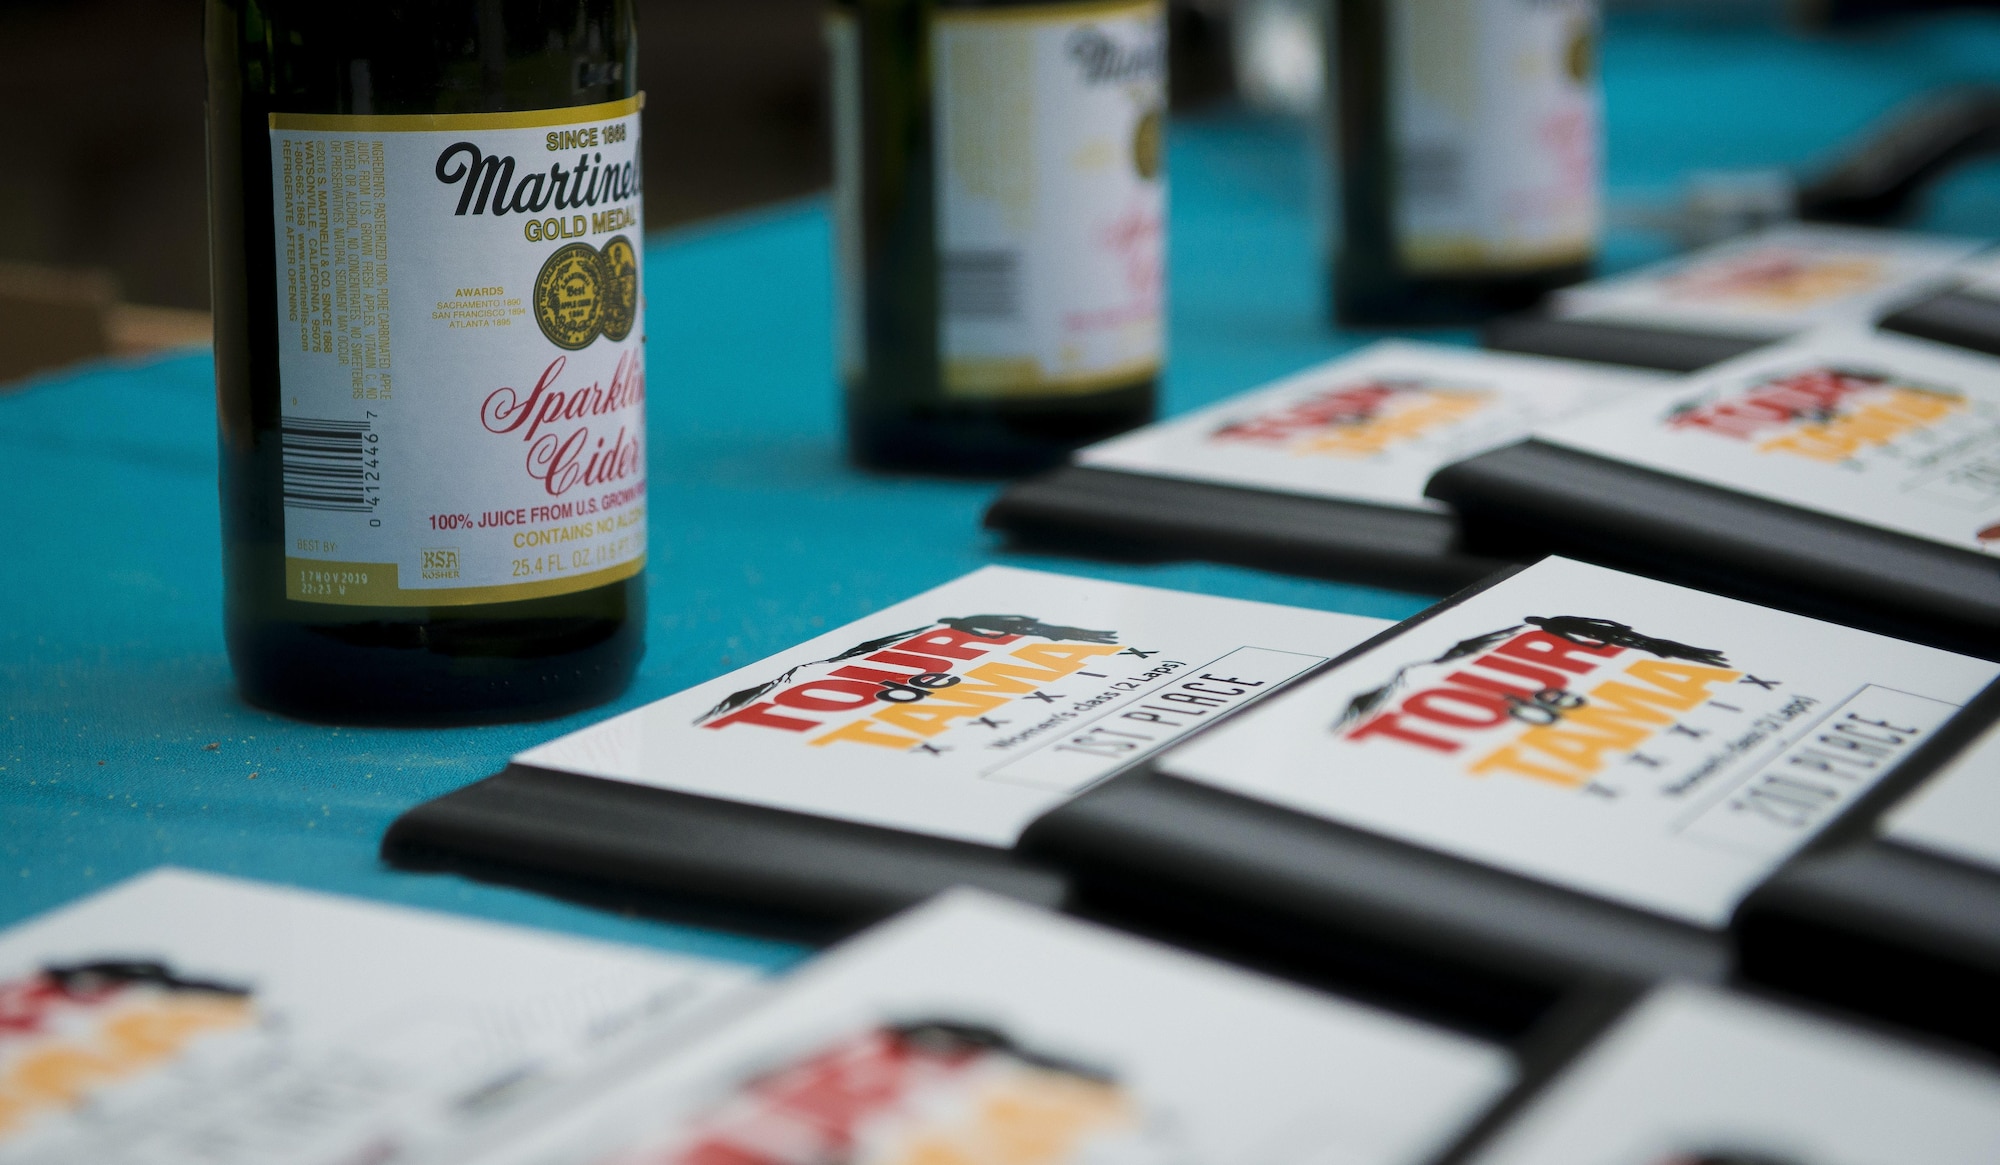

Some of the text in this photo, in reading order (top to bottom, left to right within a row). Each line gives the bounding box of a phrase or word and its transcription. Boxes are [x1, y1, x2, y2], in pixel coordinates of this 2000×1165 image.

[331, 140, 342, 152] OR
[546, 122, 626, 151] SINCE 1868
[344, 141, 356, 169] WATER
[358, 141, 370, 165] JUICE
[318, 176, 327, 187] S.
[345, 174, 356, 187] OR
[359, 170, 371, 195] FROM
[283, 140, 298, 321] REFRIGERATE AFTER OPENING
[318, 190, 329, 256] MARTINELLI
[525, 203, 636, 242] GOLD MEDAL
[334, 228, 346, 266] NATURAL
[348, 237, 359, 250] NO
[361, 223, 373, 256] GROWN
[308, 238, 319, 313] CALIFORNIA
[321, 259, 330, 267] &
[362, 261, 374, 288] FRESH
[298, 233, 309, 352] www.martinellis.com
[321, 271, 331, 289] CO.
[335, 269, 347, 313] SEDIMENT
[455, 286, 504, 297] AWARDS
[321, 293, 332, 326] SINCE
[377, 288, 389, 311] PURE
[432, 311, 451, 319] SAN
[453, 309, 506, 319] FRANCISCO
[437, 299, 500, 309] SACRAMENTO
[312, 319, 321, 353] 95076
[337, 315, 348, 333] MAY
[350, 326, 362, 338] NO
[449, 320, 490, 328] ATLANTA
[323, 330, 332, 353] 1868
[365, 333, 376, 369] VITAMIN
[378, 313, 391, 369] CARBONATED
[351, 343, 363, 400] SWEETENERS
[366, 387, 378, 400] NO
[380, 374, 391, 400] APPLE
[526, 426, 639, 496] Cider
[429, 513, 473, 530] 100%
[478, 509, 526, 528] JUICE
[531, 503, 573, 523] FROM
[576, 498, 599, 516] U.S.
[297, 538, 319, 551] BEST
[513, 521, 593, 548] CONTAINS
[597, 516, 614, 534] NO
[423, 550, 457, 569] KSA
[512, 556, 543, 577] 25.4
[422, 571, 460, 579] KOSHER
[702, 628, 1024, 732] TOUR
[876, 672, 962, 703] de
[1345, 629, 1627, 755] TOUR
[806, 643, 1128, 751] TAMA
[991, 709, 1077, 750] Women's
[1074, 691, 1121, 712] class
[1138, 660, 1187, 684] Laps)
[1505, 686, 1590, 727] de
[1054, 673, 1265, 759] 1ST PLACE
[1465, 658, 1747, 789] TAMA
